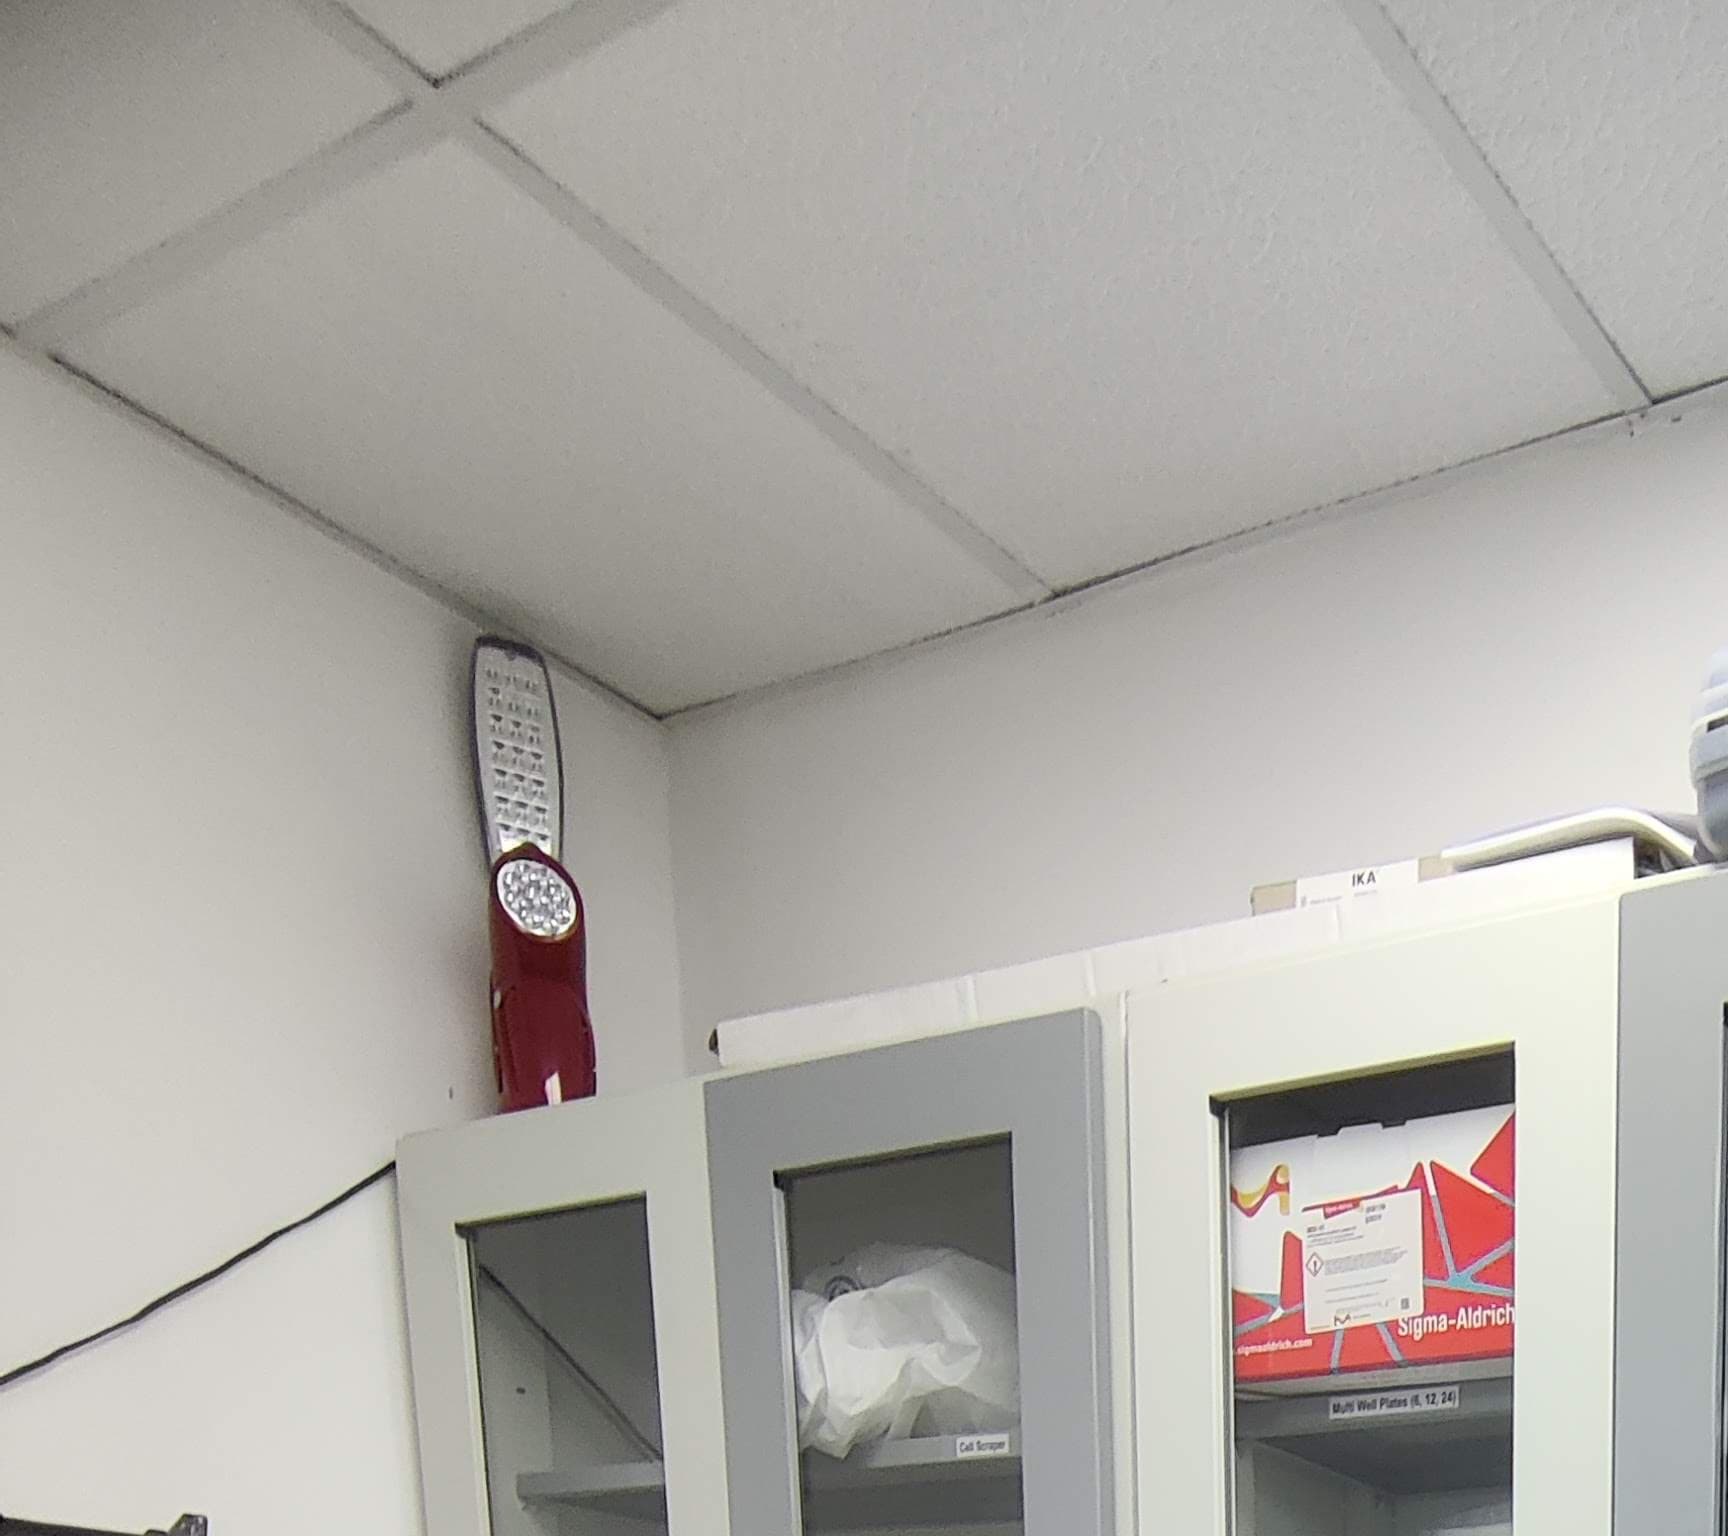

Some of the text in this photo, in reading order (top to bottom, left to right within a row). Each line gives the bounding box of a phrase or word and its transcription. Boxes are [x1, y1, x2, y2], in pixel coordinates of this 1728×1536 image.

[1351, 870, 1377, 887] IKA
[1331, 1402, 1354, 1417] Multi
[1357, 1399, 1378, 1412] Well
[1379, 1395, 1409, 1411] Plates
